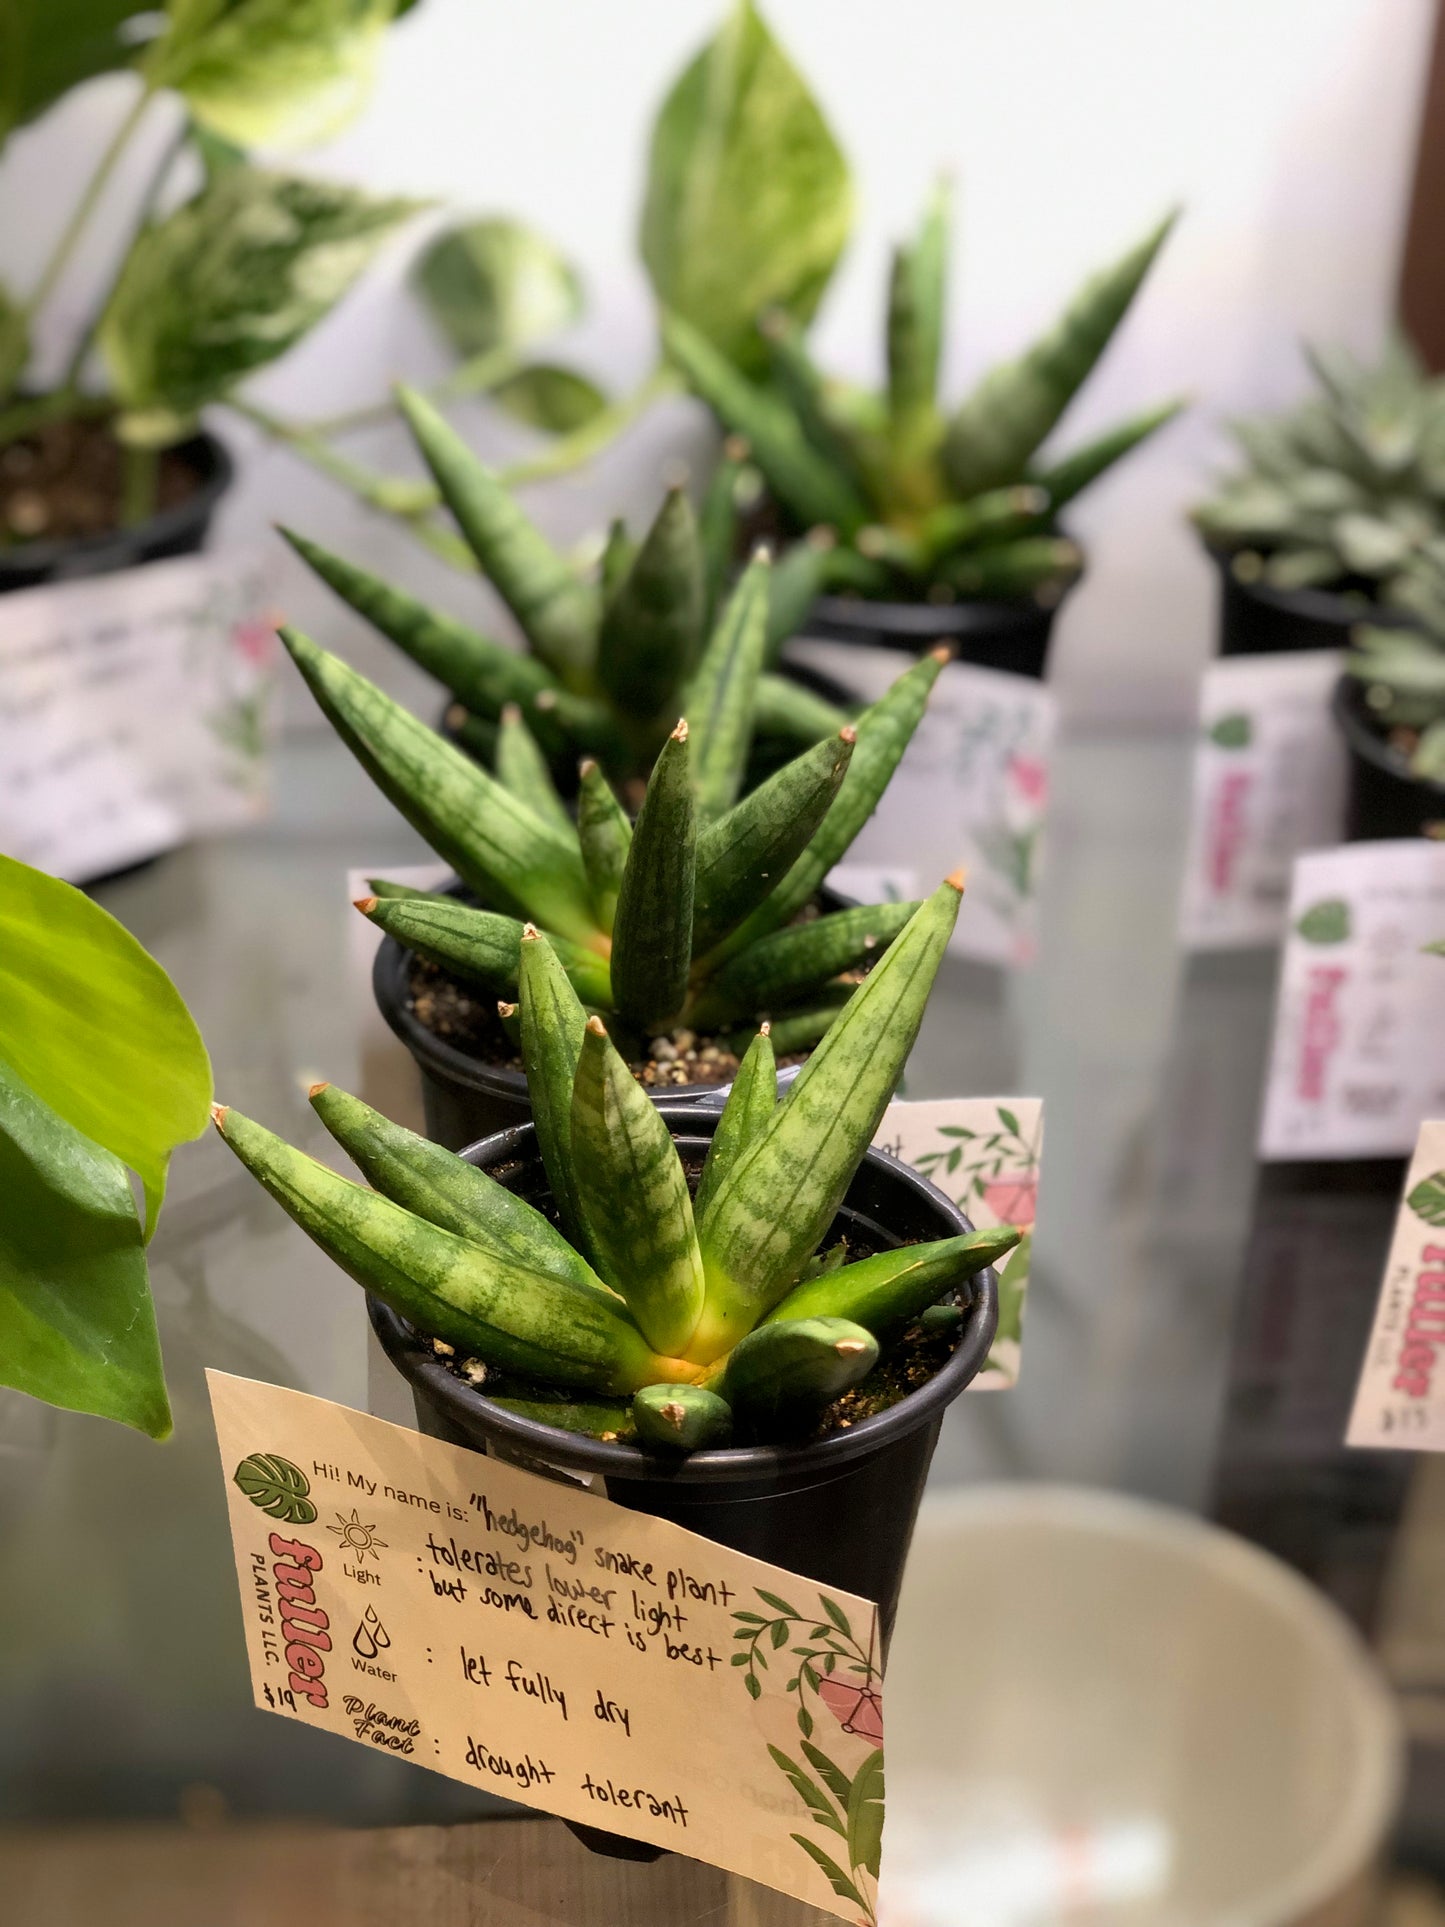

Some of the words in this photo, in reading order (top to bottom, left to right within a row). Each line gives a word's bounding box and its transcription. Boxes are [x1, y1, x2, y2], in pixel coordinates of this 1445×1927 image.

[313, 1460, 341, 1482] Hi!
[347, 1471, 377, 1496] My
[384, 1485, 441, 1513] name
[446, 1502, 469, 1523] is:
[469, 1493, 584, 1565] "hedgehog"
[594, 1547, 657, 1586] snake
[667, 1568, 736, 1607] plant
[250, 1552, 275, 1624] PLANTS
[343, 1563, 382, 1586] Light
[426, 1533, 533, 1588] tolerates
[545, 1563, 617, 1610] lower
[632, 1590, 688, 1636] light
[261, 1630, 280, 1667] LLC.
[268, 1532, 332, 1709] fuller
[429, 1570, 467, 1603] but
[480, 1587, 538, 1620] some
[547, 1595, 615, 1638] direct
[624, 1623, 647, 1652] is
[664, 1633, 723, 1671] best
[263, 1682, 298, 1712] $19
[351, 1657, 398, 1683] Water
[460, 1646, 492, 1686] let
[504, 1660, 568, 1721] fully
[594, 1689, 631, 1737] dry
[343, 1695, 421, 1736] Plant
[353, 1718, 415, 1755] Fact
[465, 1736, 556, 1788] drought
[581, 1773, 689, 1827] tolerant
